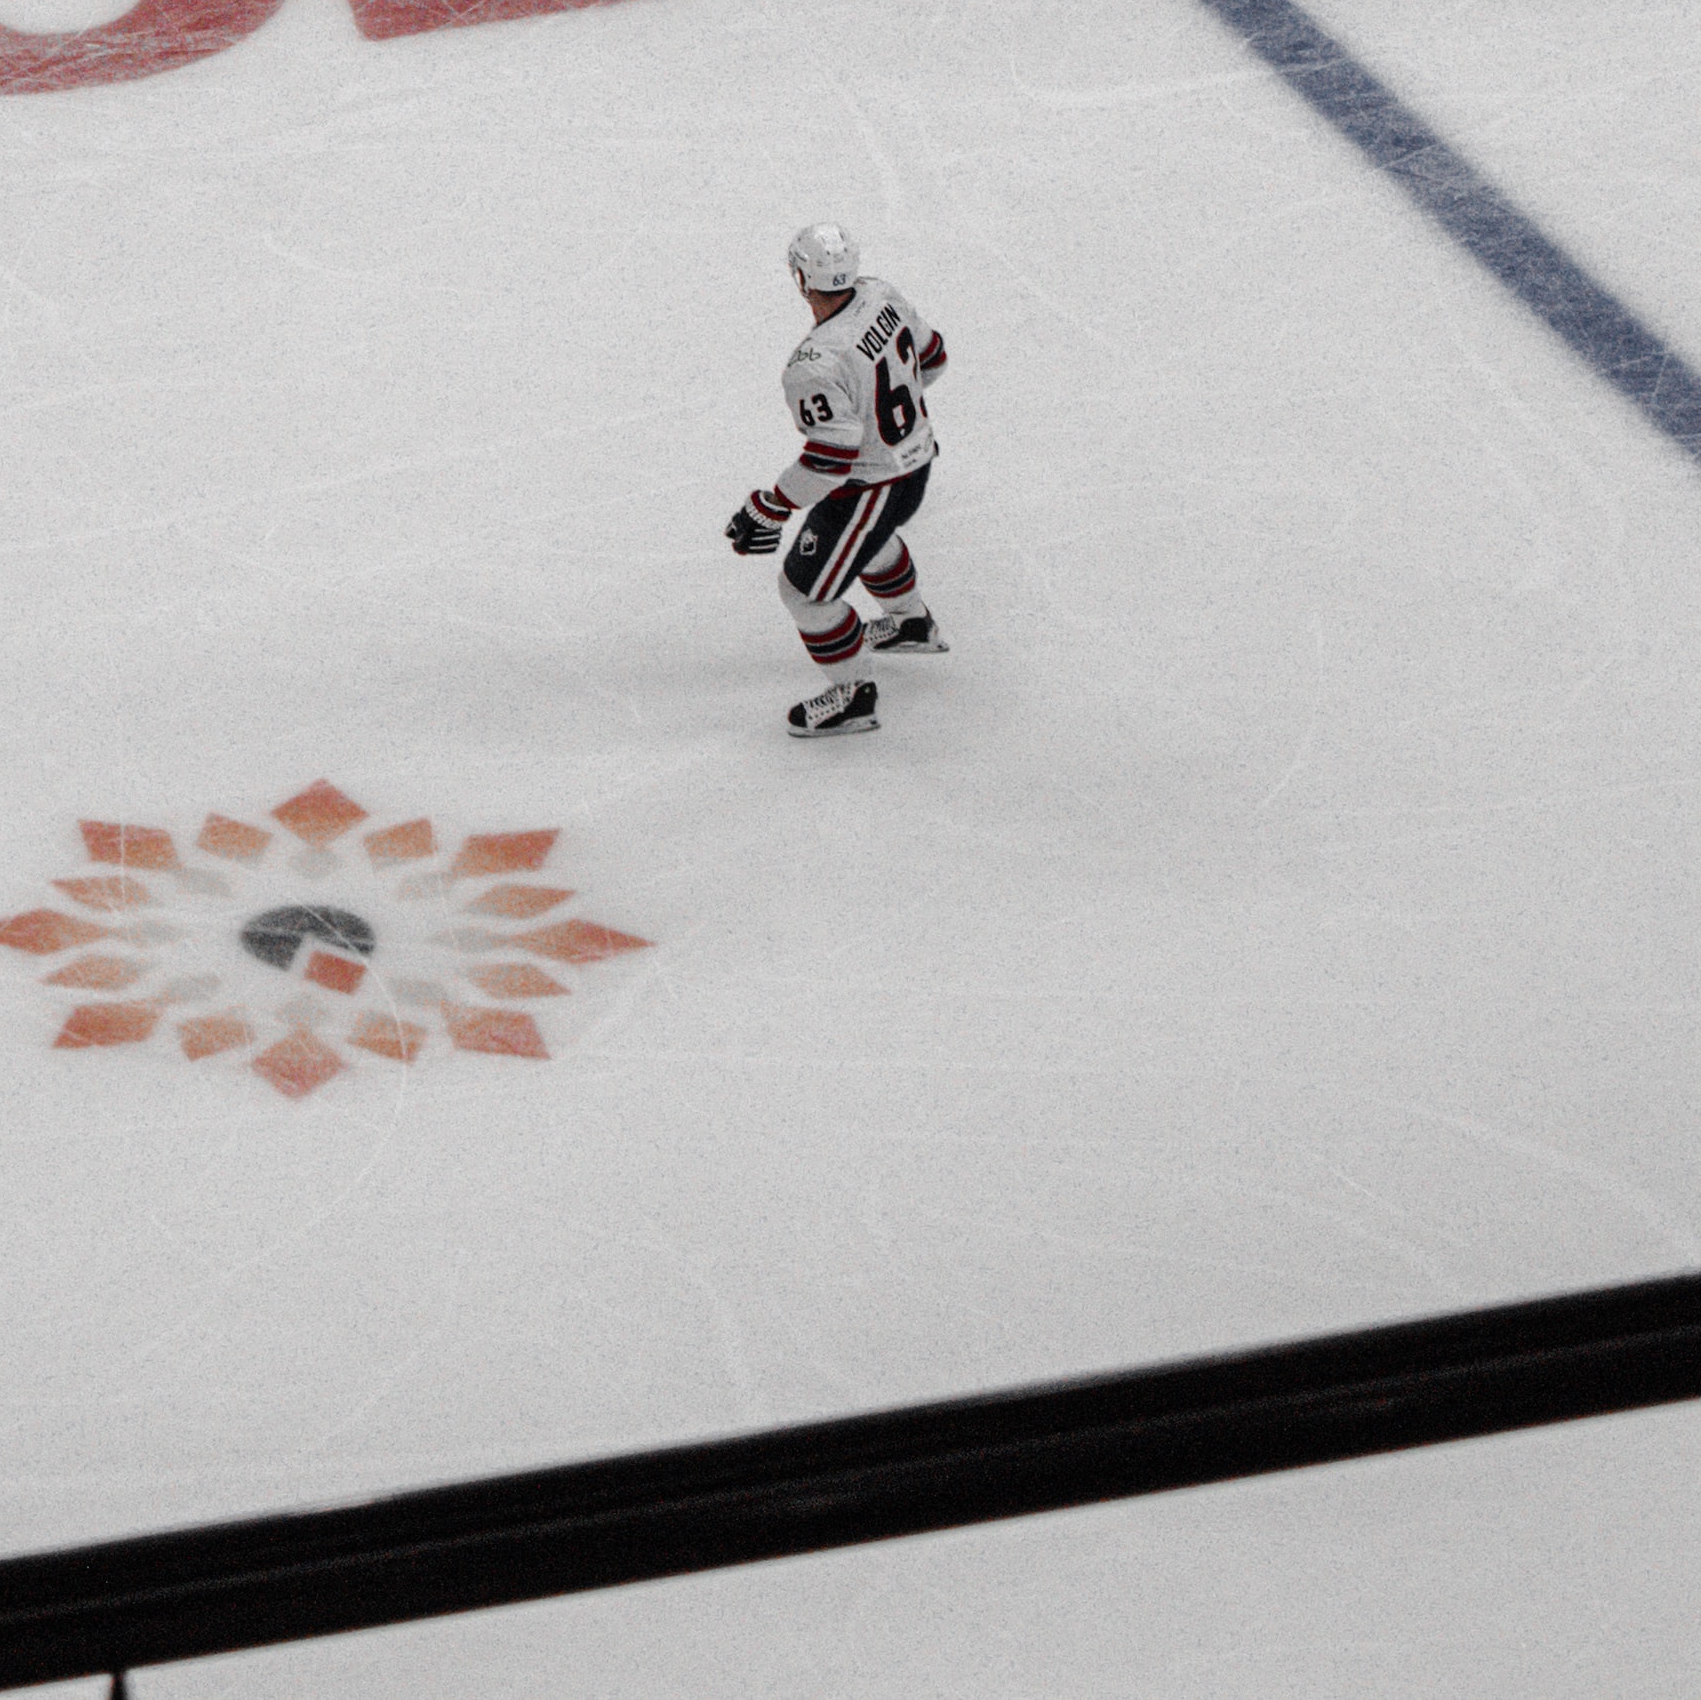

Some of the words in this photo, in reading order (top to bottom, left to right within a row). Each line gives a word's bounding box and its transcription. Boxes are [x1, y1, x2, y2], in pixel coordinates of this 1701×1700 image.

[833, 272, 847, 286] 63
[875, 326, 930, 447] 63
[799, 393, 833, 427] 63
